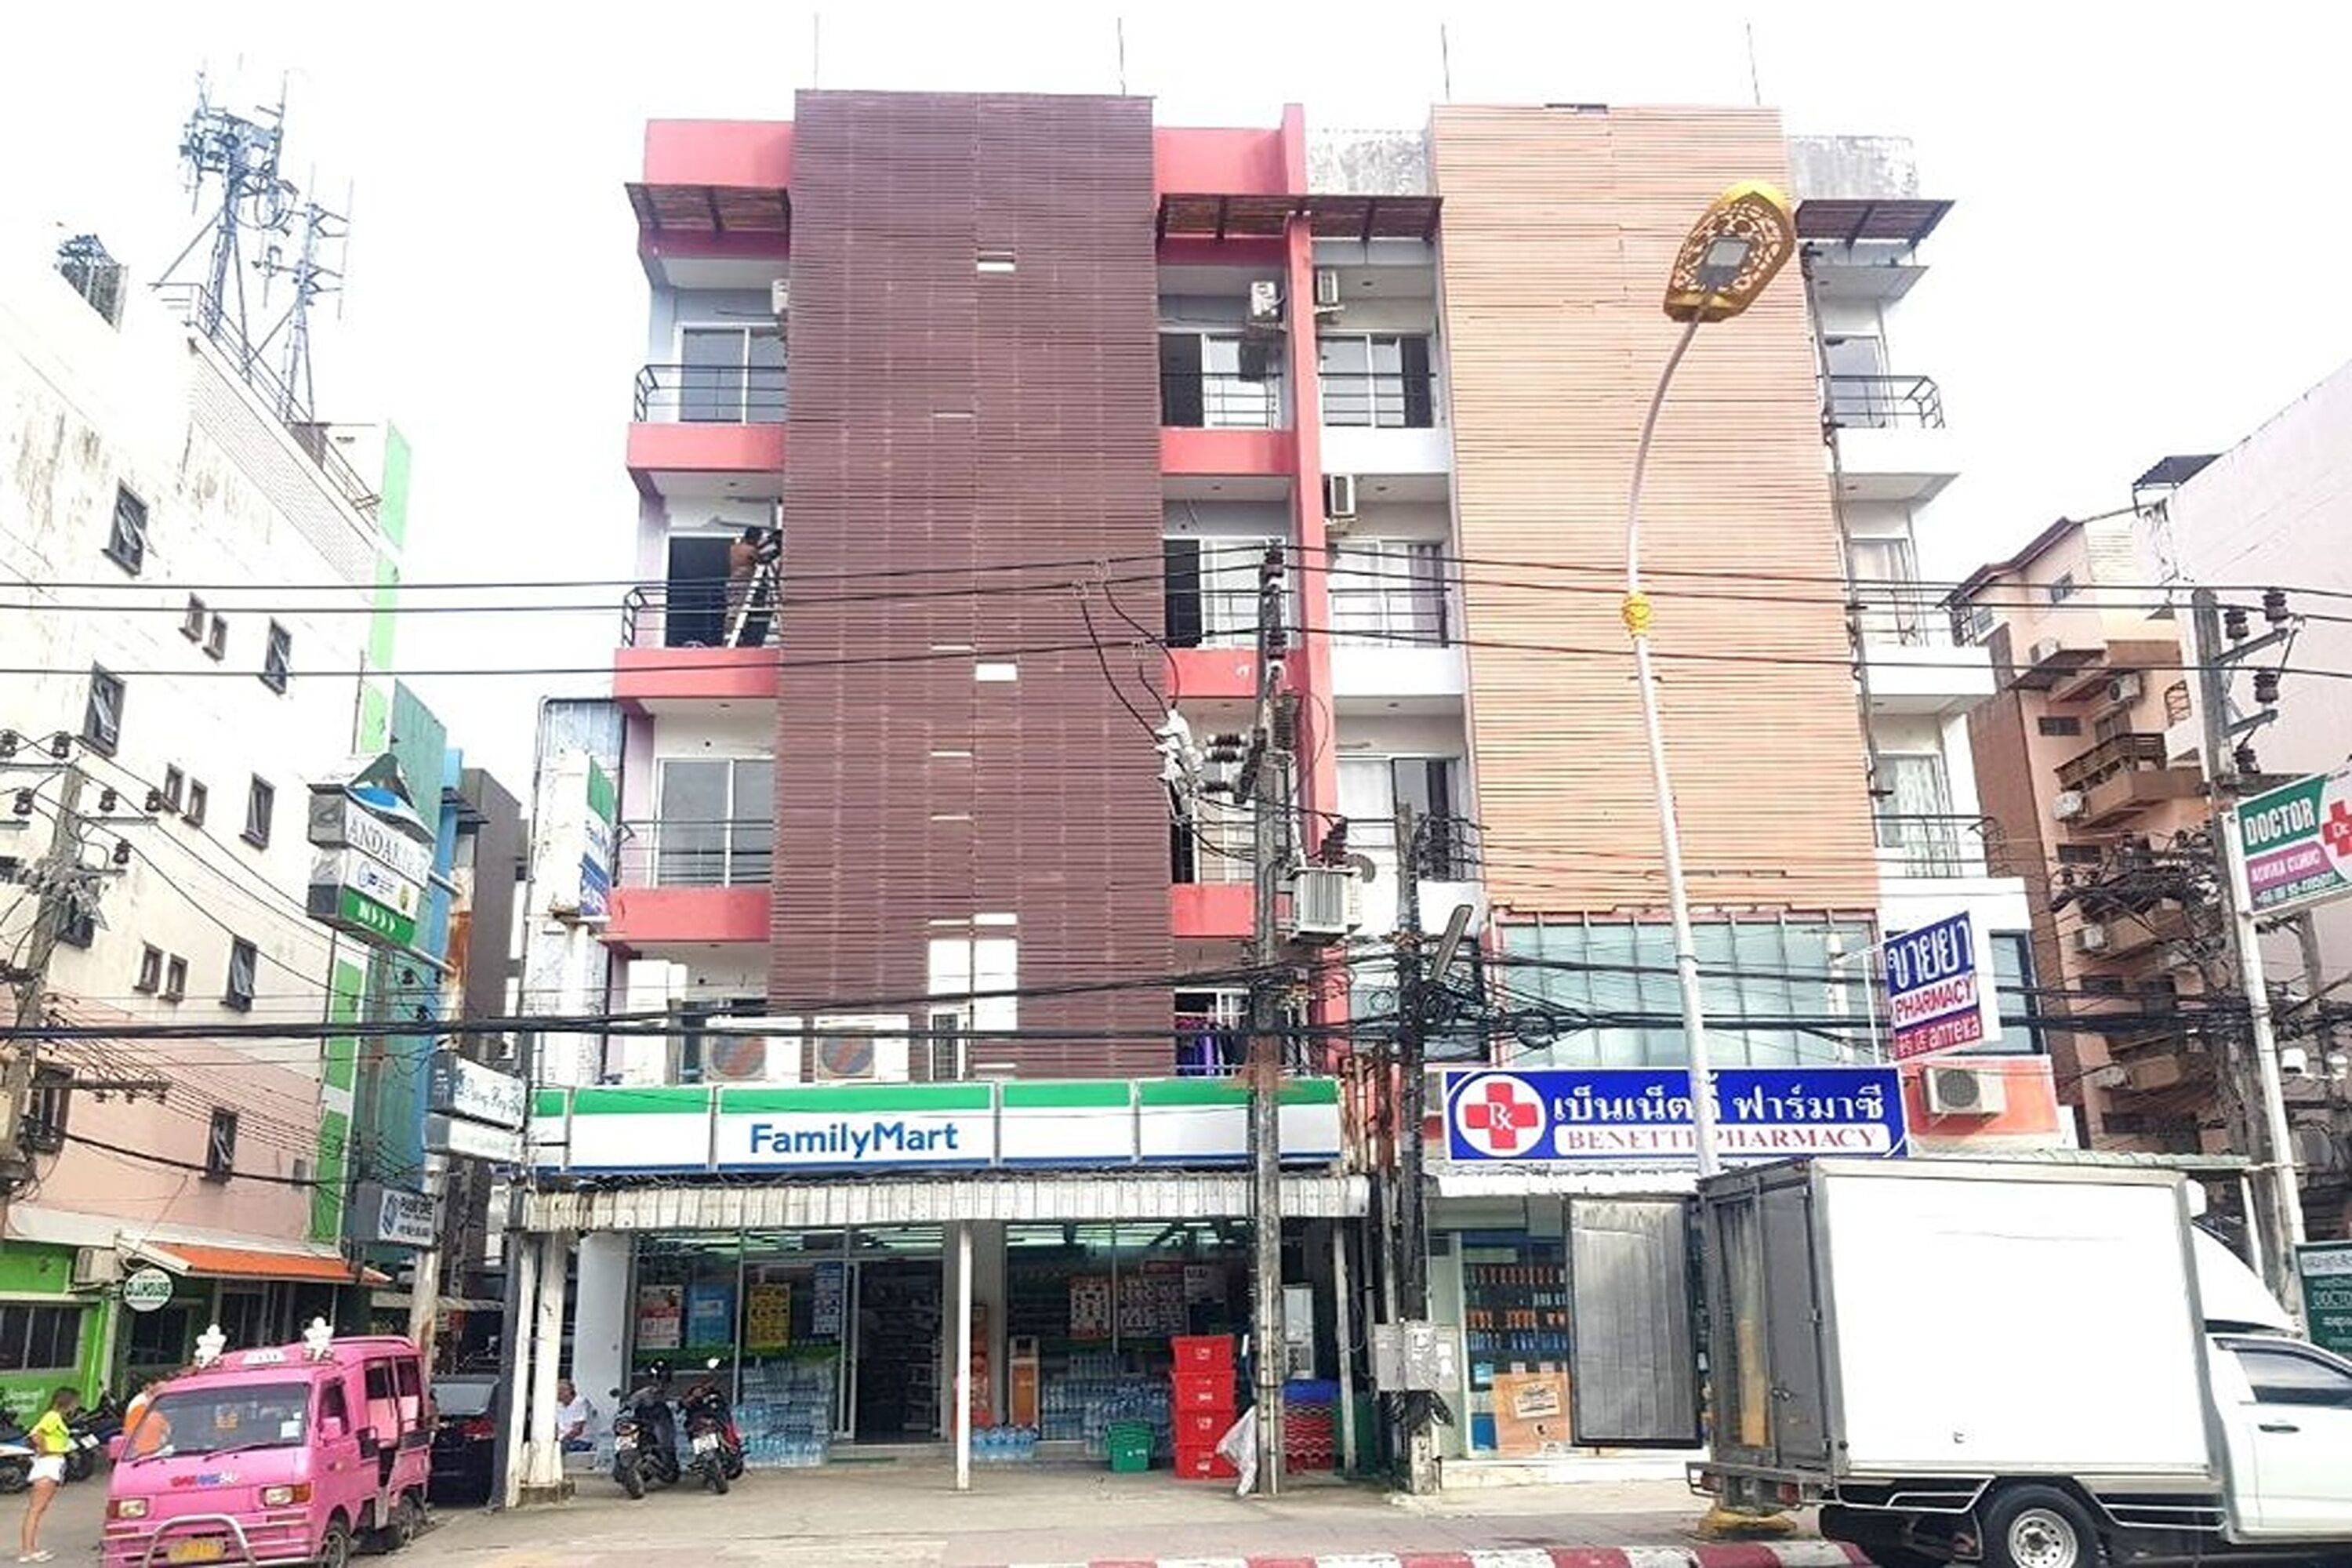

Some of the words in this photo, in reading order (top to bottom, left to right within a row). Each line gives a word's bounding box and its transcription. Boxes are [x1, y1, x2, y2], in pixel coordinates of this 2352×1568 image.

[2244, 797, 2315, 847] DOCTOR
[1888, 920, 1973, 989] ขายยา
[1893, 975, 1977, 1022] PHARMACY
[1733, 1085, 1883, 1120] ฟาร์มาซี
[750, 1121, 958, 1159] FamilyMart
